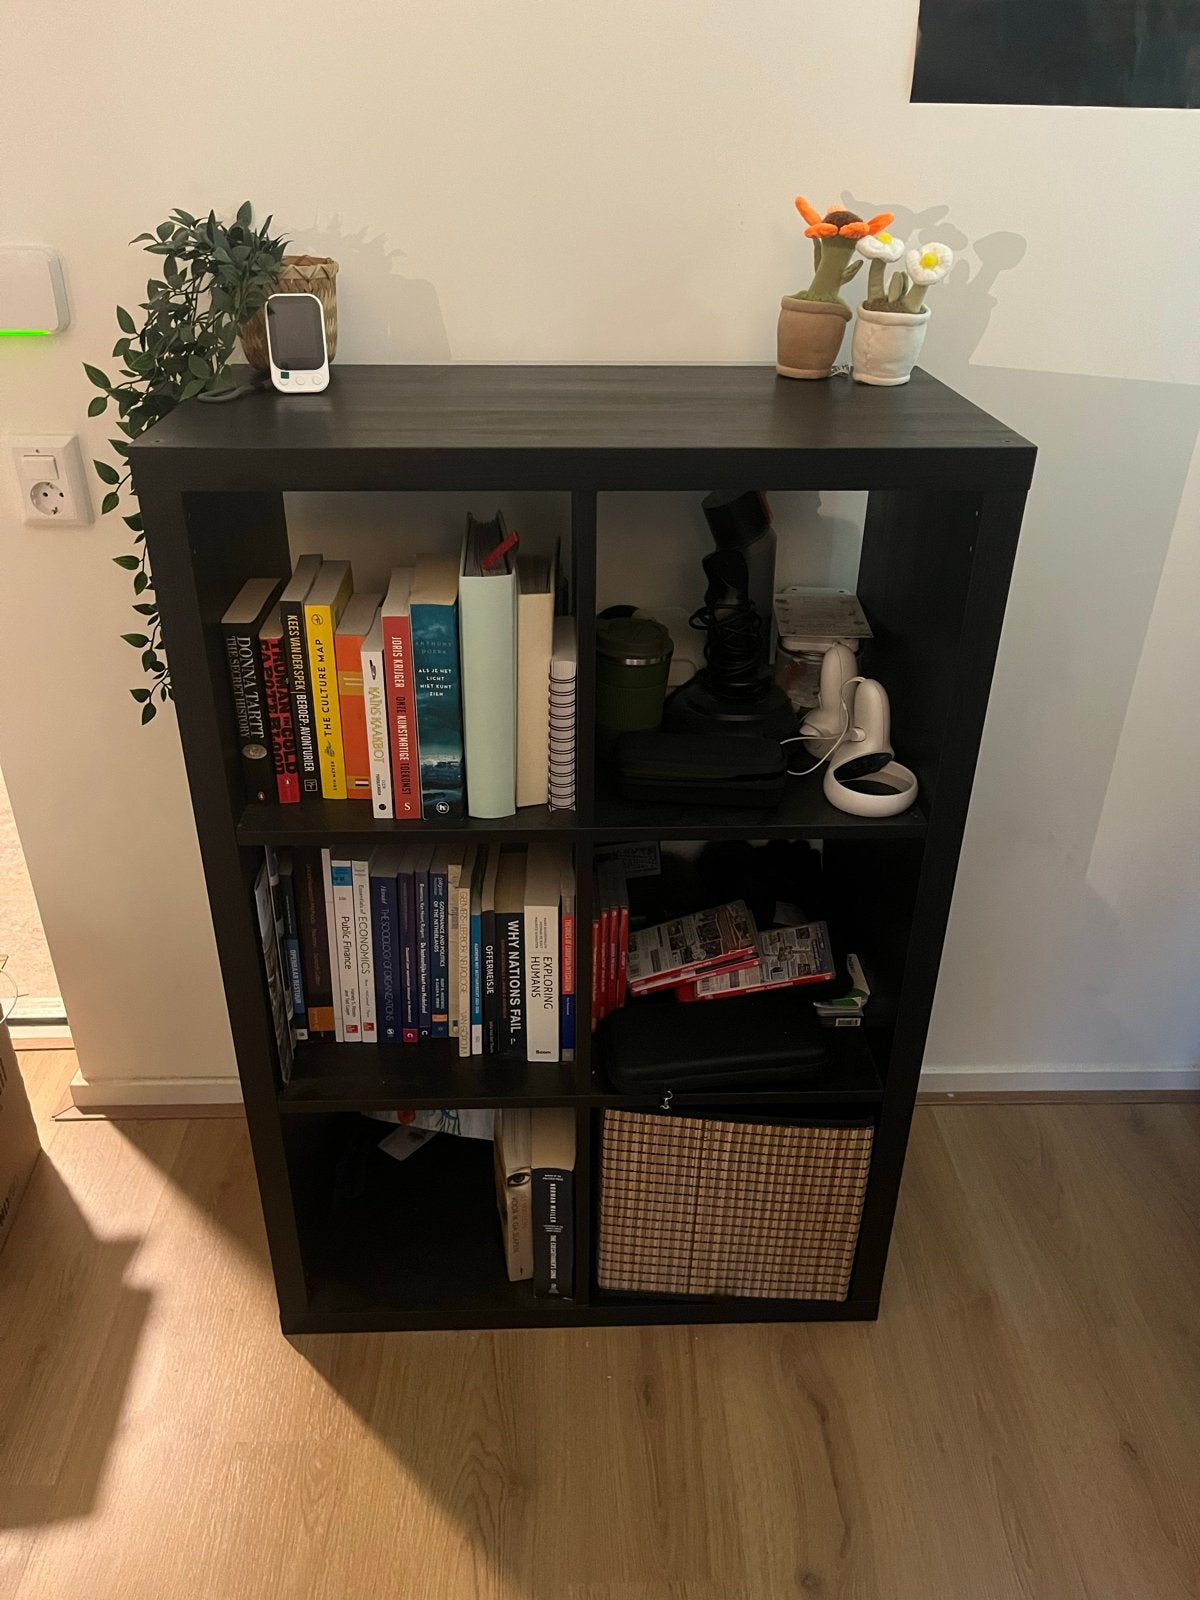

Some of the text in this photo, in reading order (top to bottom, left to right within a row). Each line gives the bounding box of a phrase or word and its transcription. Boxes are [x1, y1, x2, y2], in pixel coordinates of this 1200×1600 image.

[271, 640, 291, 713] TRUMAN
[287, 615, 306, 691] KEES VAN DER SPEK
[391, 636, 405, 688] JORIS KRIJGER
[226, 635, 251, 738] THE SECRET HISTORY
[236, 636, 265, 739] DONNA TARTT
[315, 639, 333, 737] THE CULTURE MAP
[280, 728, 298, 774] COLD
[371, 717, 385, 764] KAAKBOT
[395, 696, 411, 795] ONZE KUNSTMATIGE TOEKOMST
[358, 884, 366, 908] Essentials
[433, 900, 440, 908] OF
[340, 916, 353, 970] Public Finance
[358, 916, 371, 975] ECONOMICS
[508, 920, 520, 949] WHY
[564, 919, 573, 938] THEORIES
[289, 949, 303, 1005] OPENBAAR BESTUUR
[381, 909, 394, 1021] THE SOCIOLOGY OF ORGANIZATIONS
[485, 944, 495, 996] OFFERMEISJE
[508, 951, 521, 1006] NATIONS
[531, 956, 541, 998] HUMANS
[543, 956, 553, 1010] EXPLORING
[510, 1008, 522, 1034] FAIL
[549, 1183, 557, 1223] NORMAN MAILER
[549, 1234, 557, 1242] THE
